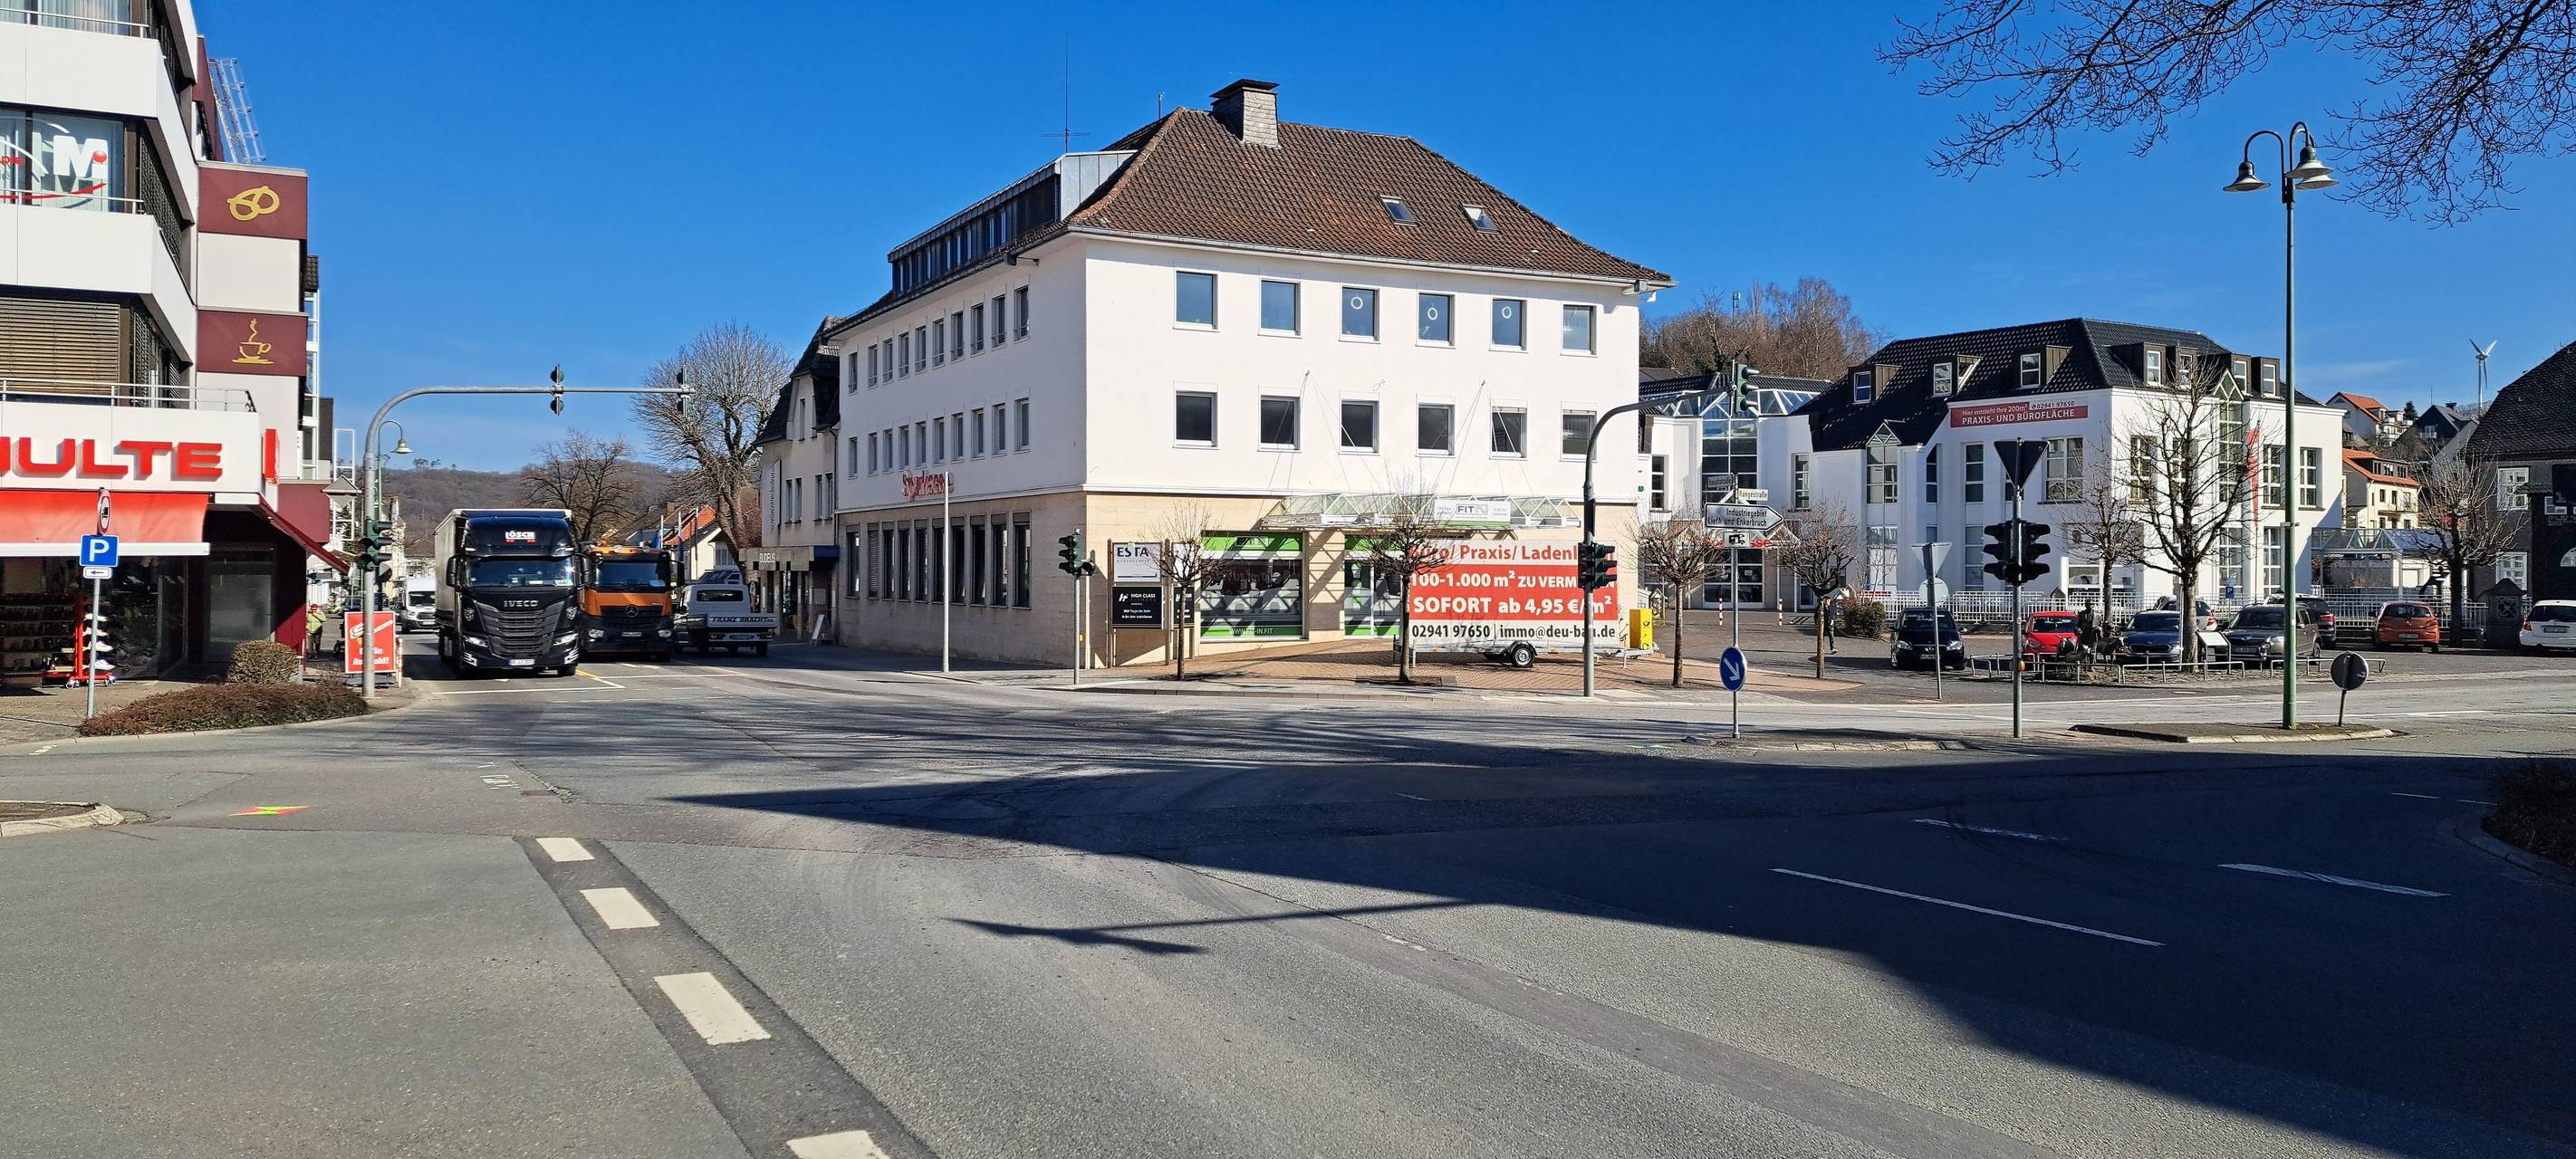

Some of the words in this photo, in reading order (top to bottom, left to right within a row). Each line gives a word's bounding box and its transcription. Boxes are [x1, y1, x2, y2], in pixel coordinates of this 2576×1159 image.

[1962, 416, 1994, 425] PRAXIS-
[1996, 414, 2015, 422] UND
[2017, 408, 2074, 420] BÜROFLÄCHE
[1725, 508, 1767, 518] Industriegebiet
[1707, 516, 1722, 524] Lieth
[1724, 517, 1734, 525] und
[1736, 518, 1767, 527] Enkerbruch
[89, 539, 110, 562] P
[1460, 544, 1517, 560] Praxis/
[1410, 572, 1491, 588] 100-1.000
[1494, 570, 1515, 588] m²
[1518, 576, 1536, 588] ZU
[1413, 597, 1492, 613] SOFORT
[1498, 597, 1521, 614] ab
[1524, 598, 1564, 616] 4,95
[1412, 625, 1449, 637] 02941
[1452, 625, 1491, 637] 97650
